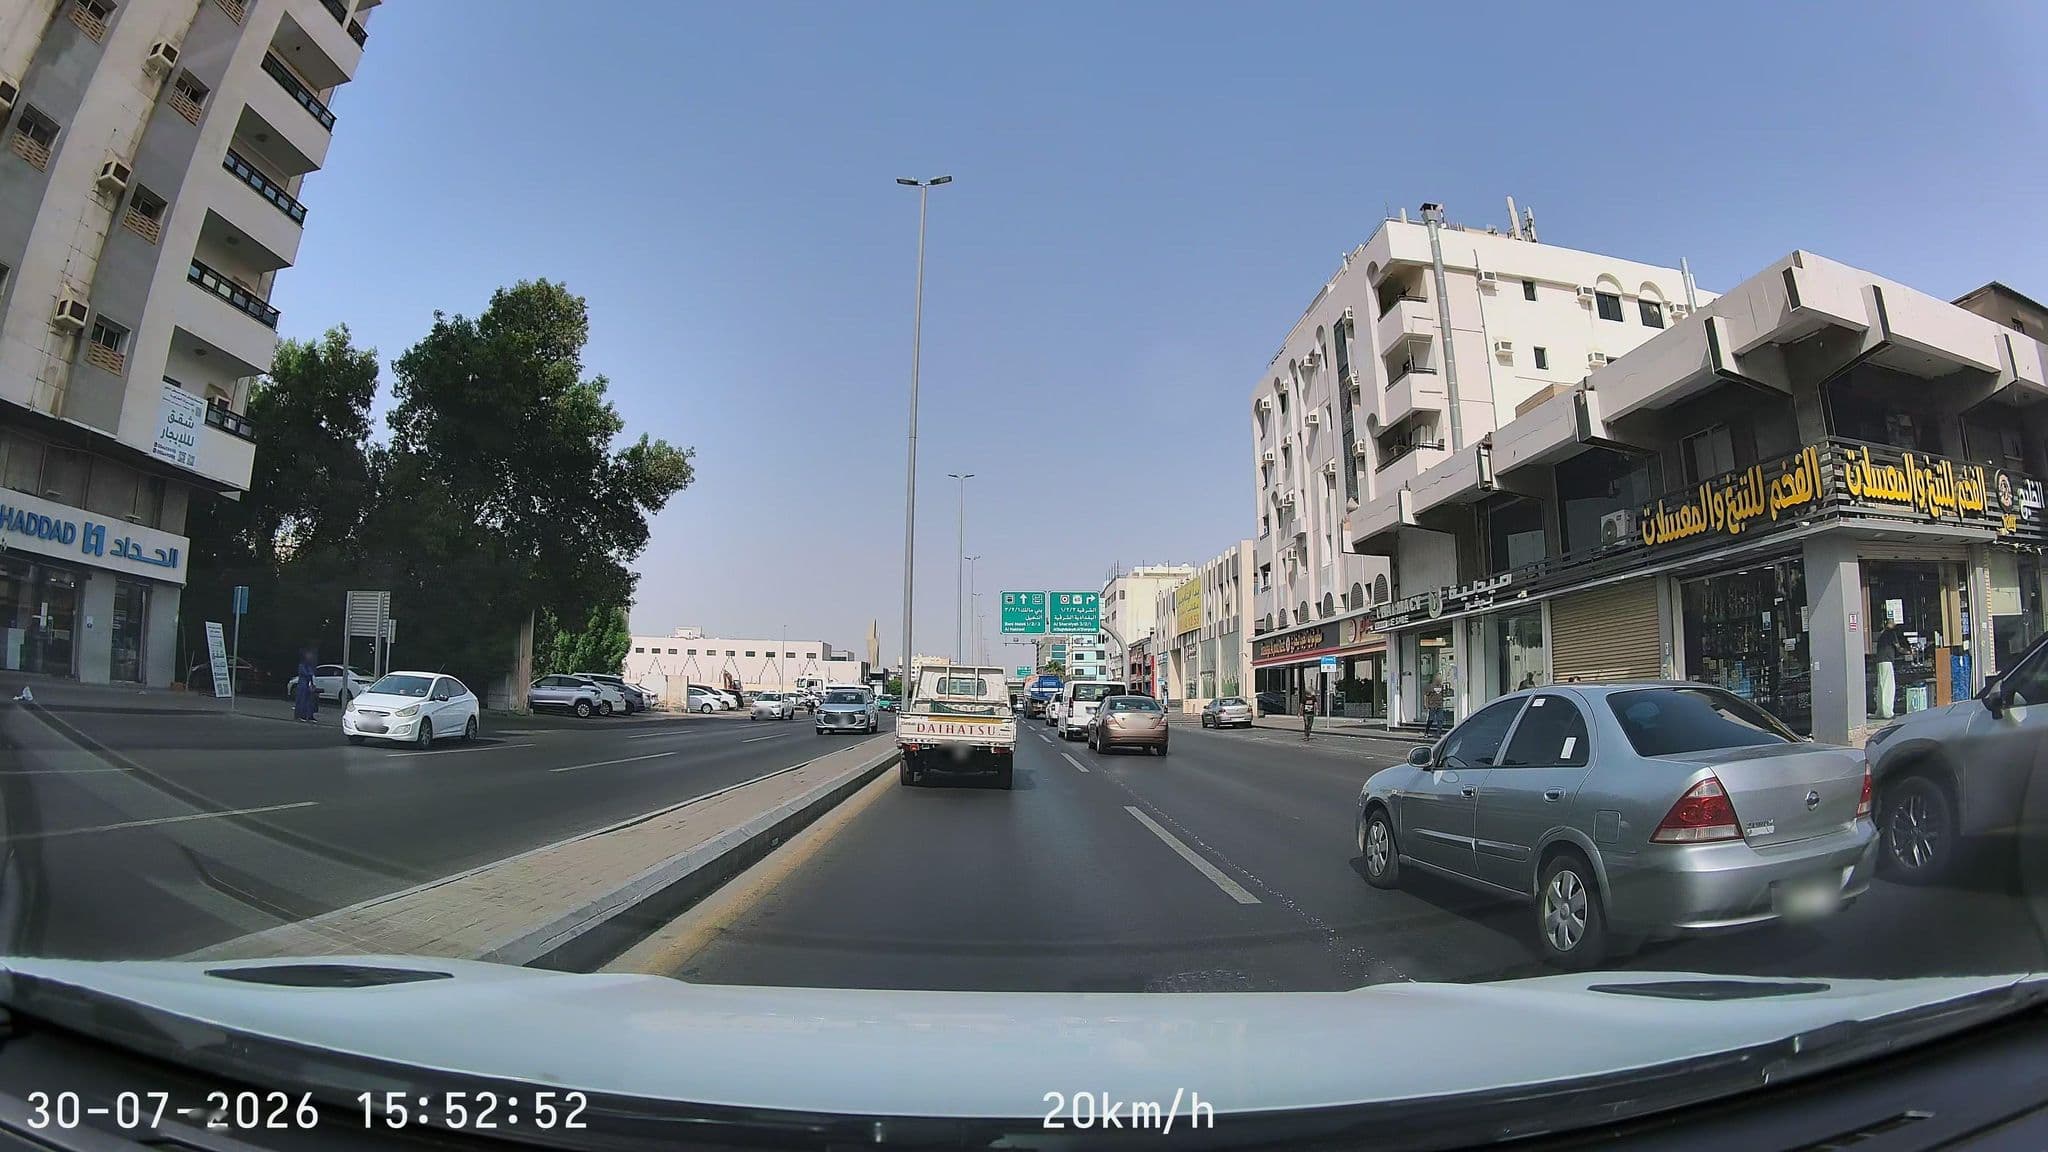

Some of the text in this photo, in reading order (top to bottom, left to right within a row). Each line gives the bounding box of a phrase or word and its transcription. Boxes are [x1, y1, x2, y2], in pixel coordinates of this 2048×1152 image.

[167, 409, 195, 429] شقق
[1642, 445, 1823, 546] الفخم للتبغ والمعسلات
[1845, 445, 1988, 520] الفخم للتبغ والمعسلات
[0, 504, 77, 545] HADDAD
[110, 536, 179, 569] الحداد
[1448, 573, 1513, 602] صيدلية
[917, 722, 996, 736] DAIHATSU
